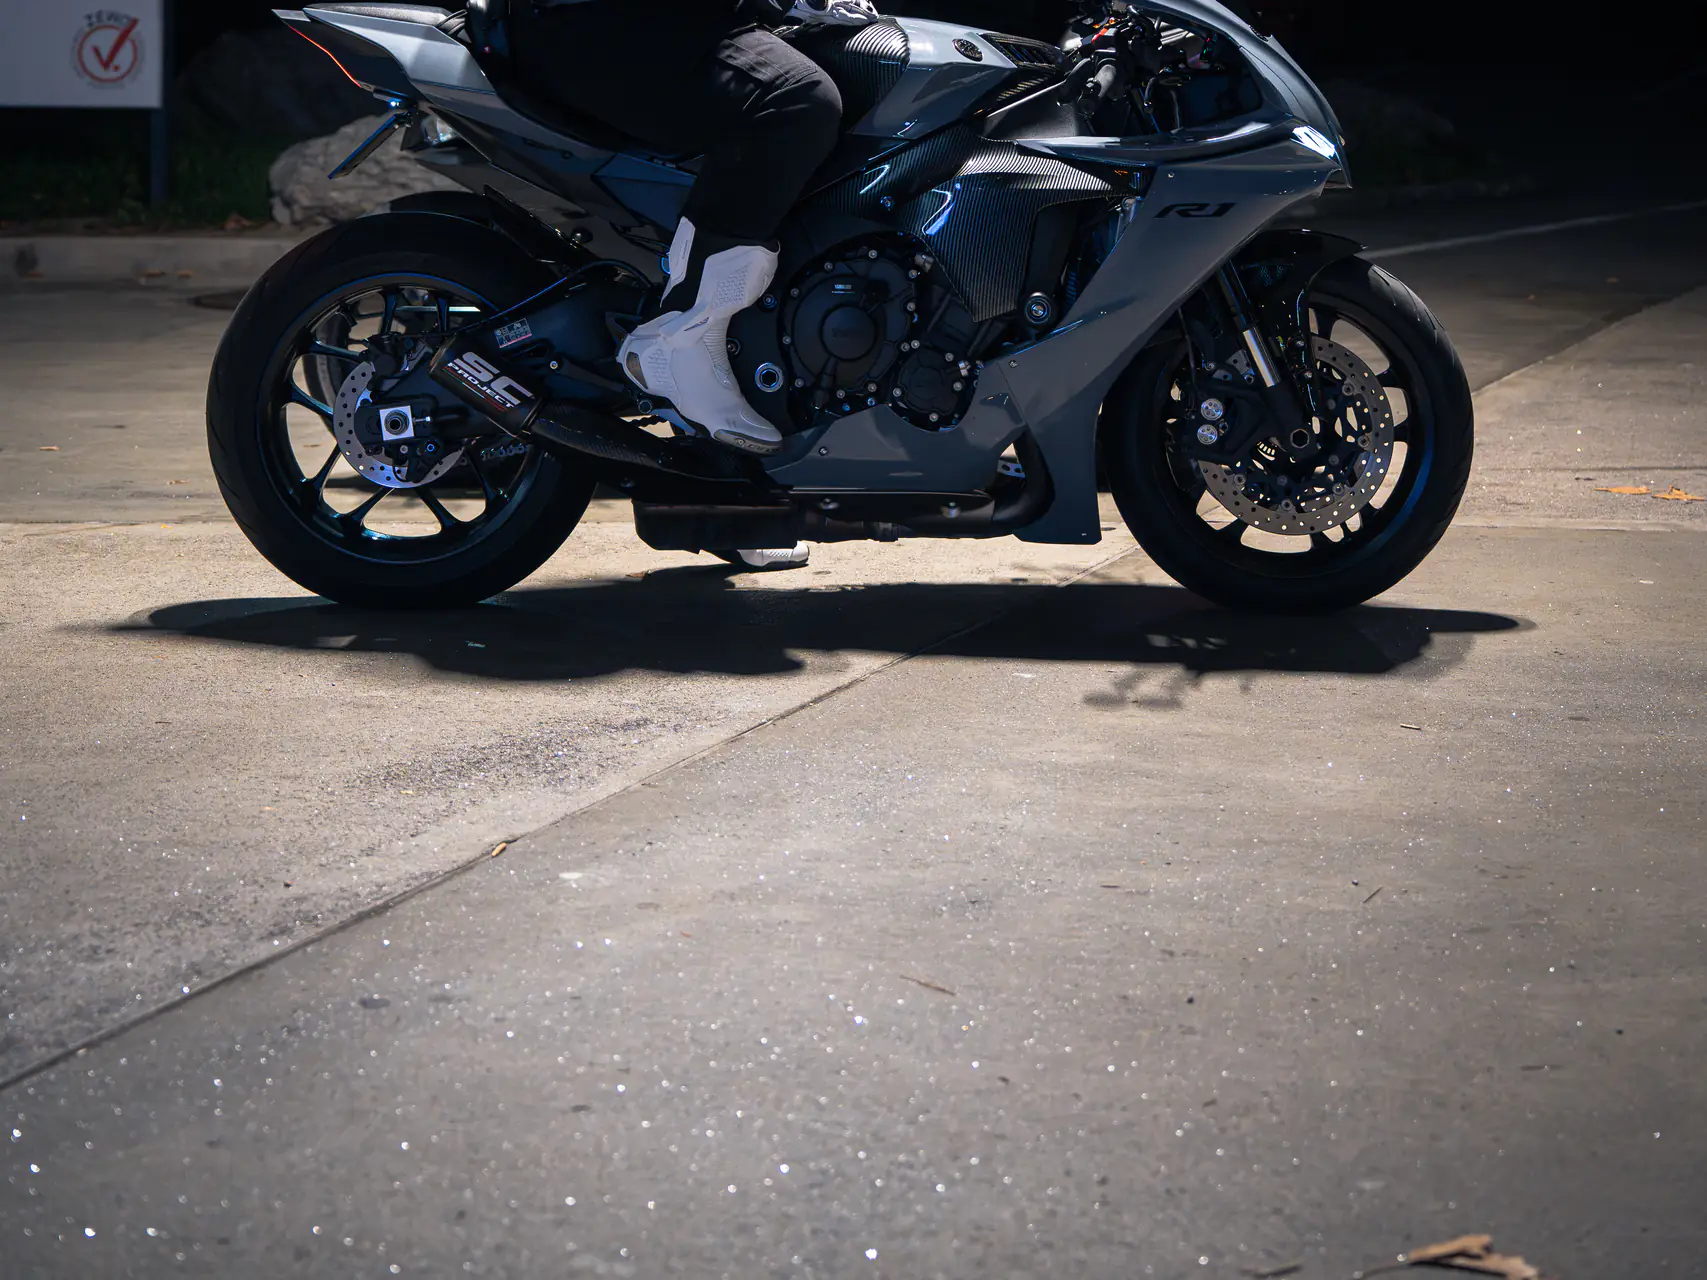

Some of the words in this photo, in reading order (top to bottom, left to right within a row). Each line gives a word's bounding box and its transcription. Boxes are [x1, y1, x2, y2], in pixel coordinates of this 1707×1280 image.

[1152, 202, 1237, 218] R1
[447, 362, 515, 408] PROJECT
[453, 351, 533, 405] SC
